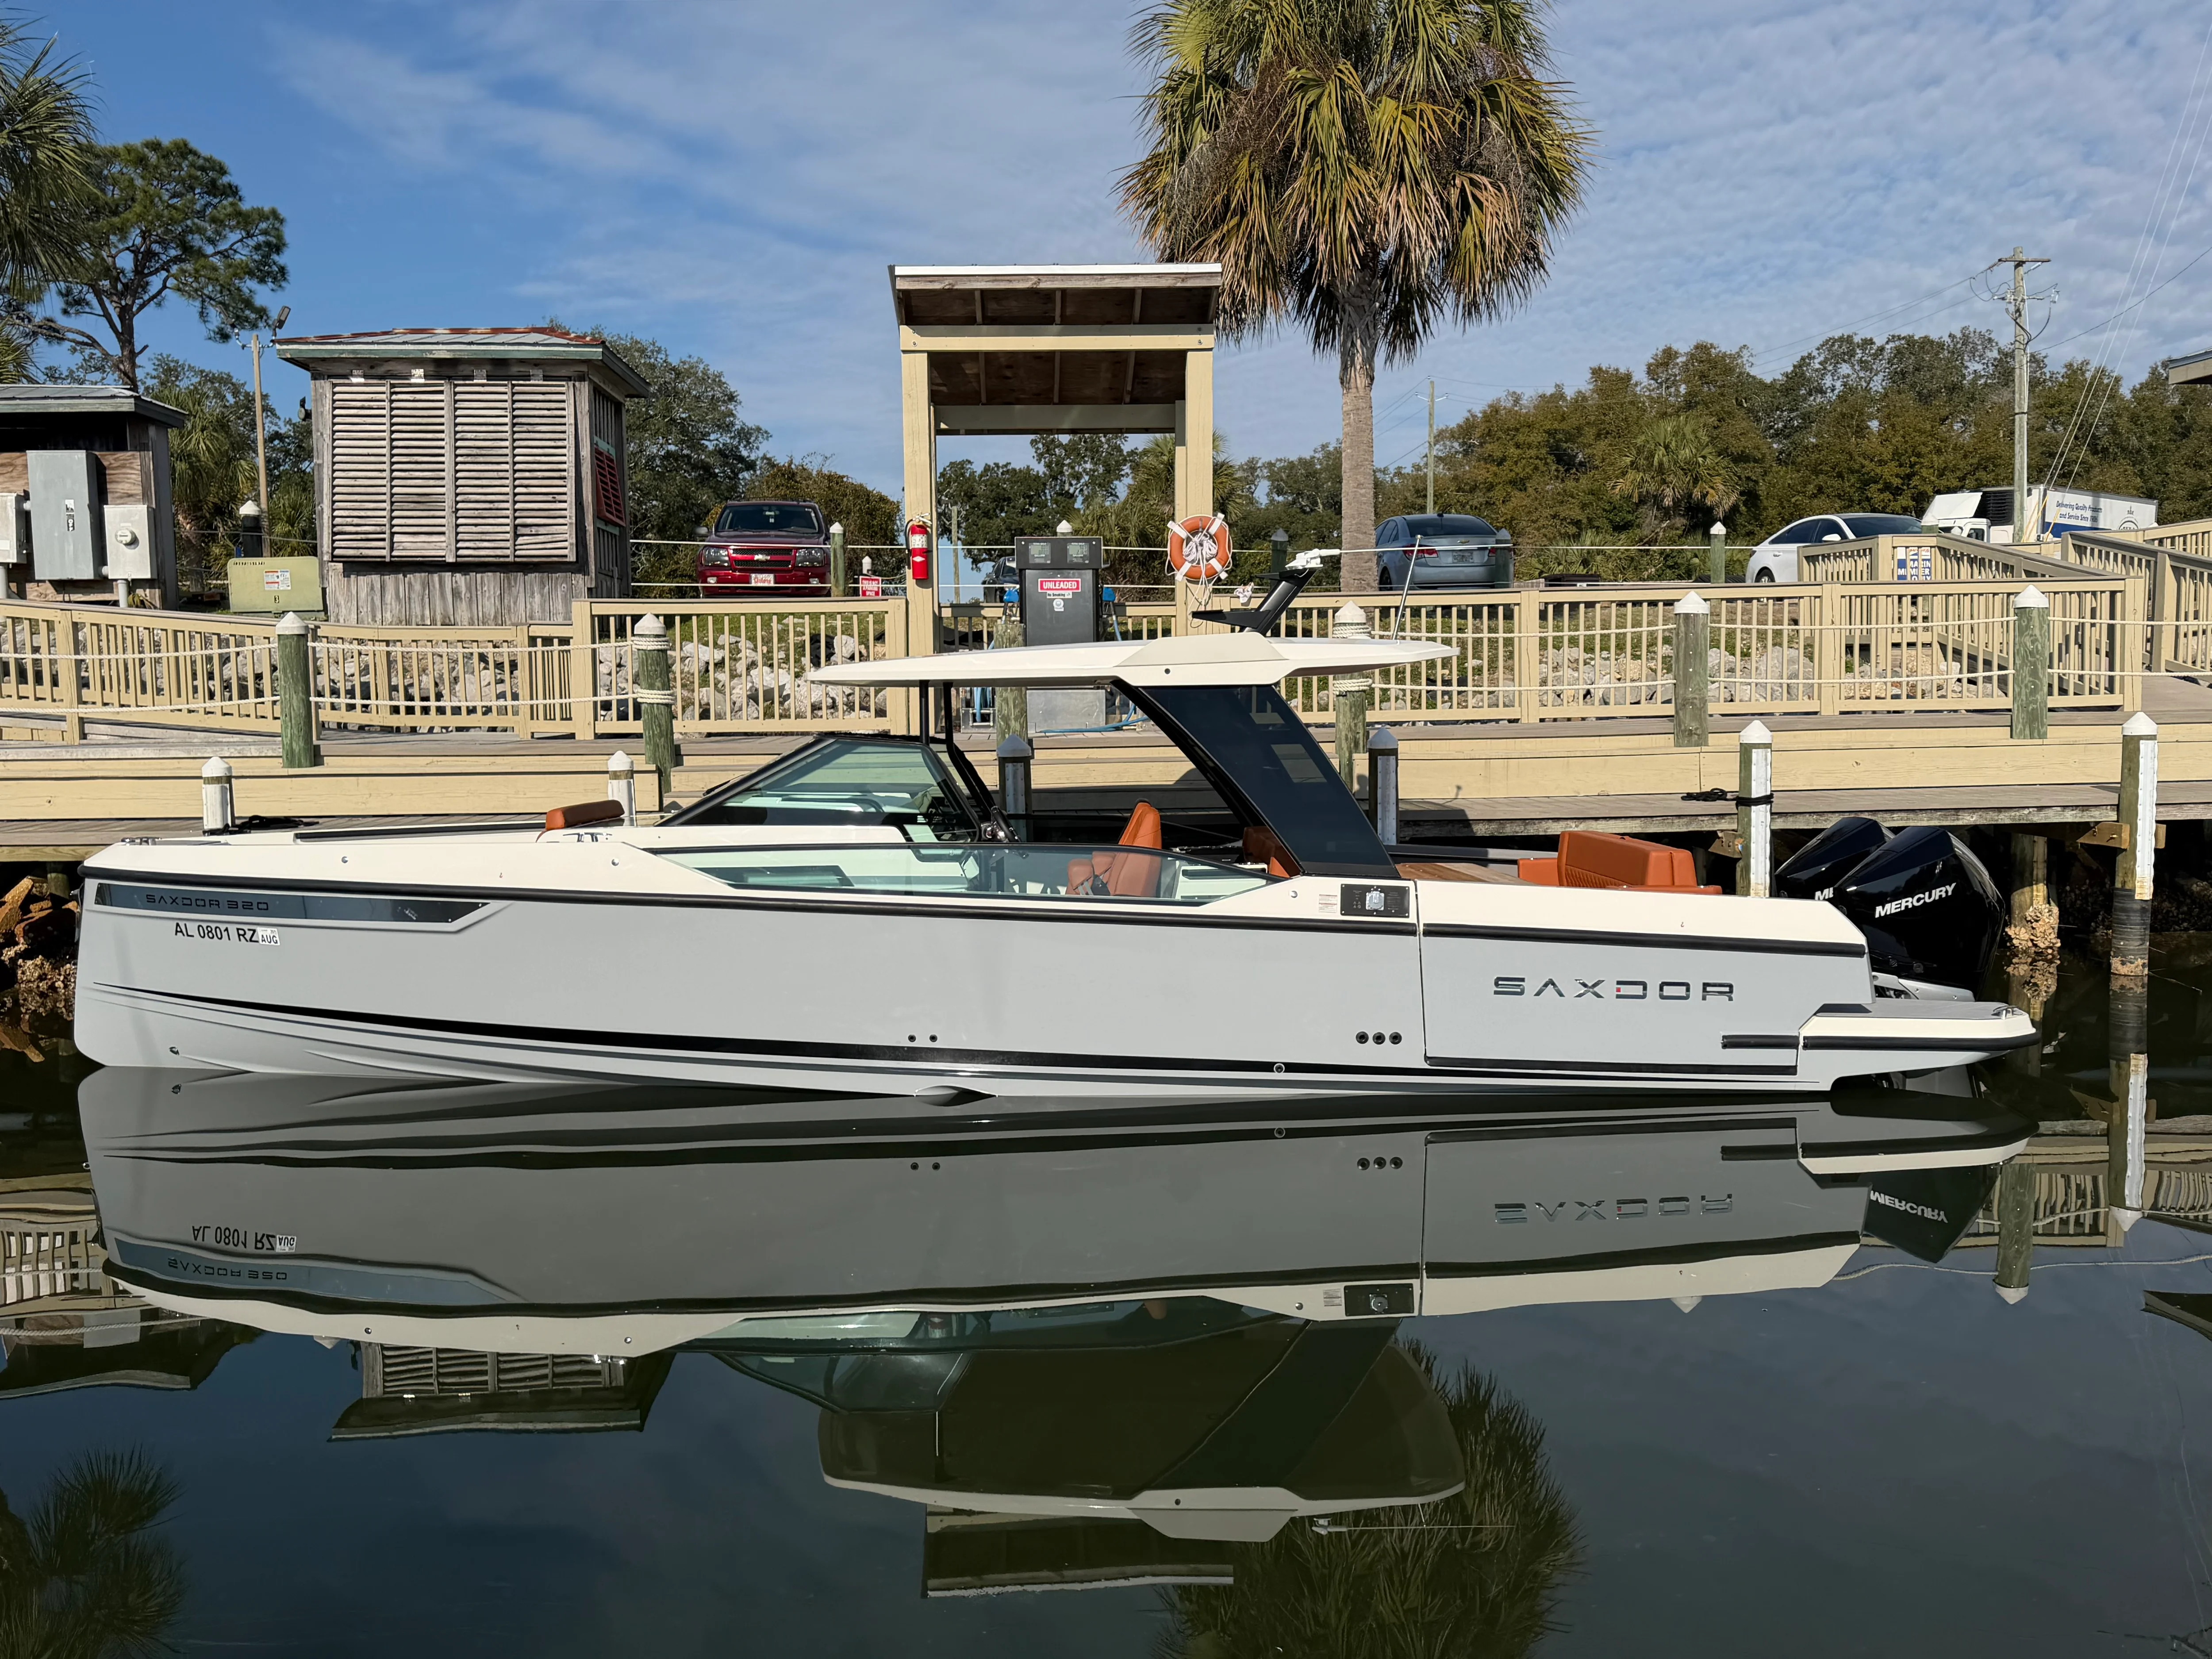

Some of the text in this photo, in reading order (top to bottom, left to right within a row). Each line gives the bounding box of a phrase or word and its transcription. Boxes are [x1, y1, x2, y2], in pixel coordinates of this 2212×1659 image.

[146, 894, 269, 911] SAXDOR 320
[1874, 883, 1957, 918] MERCURY
[174, 922, 259, 943] AL 0801 RZ
[261, 934, 278, 944] AUG
[1494, 976, 1734, 1002] SAXDOR
